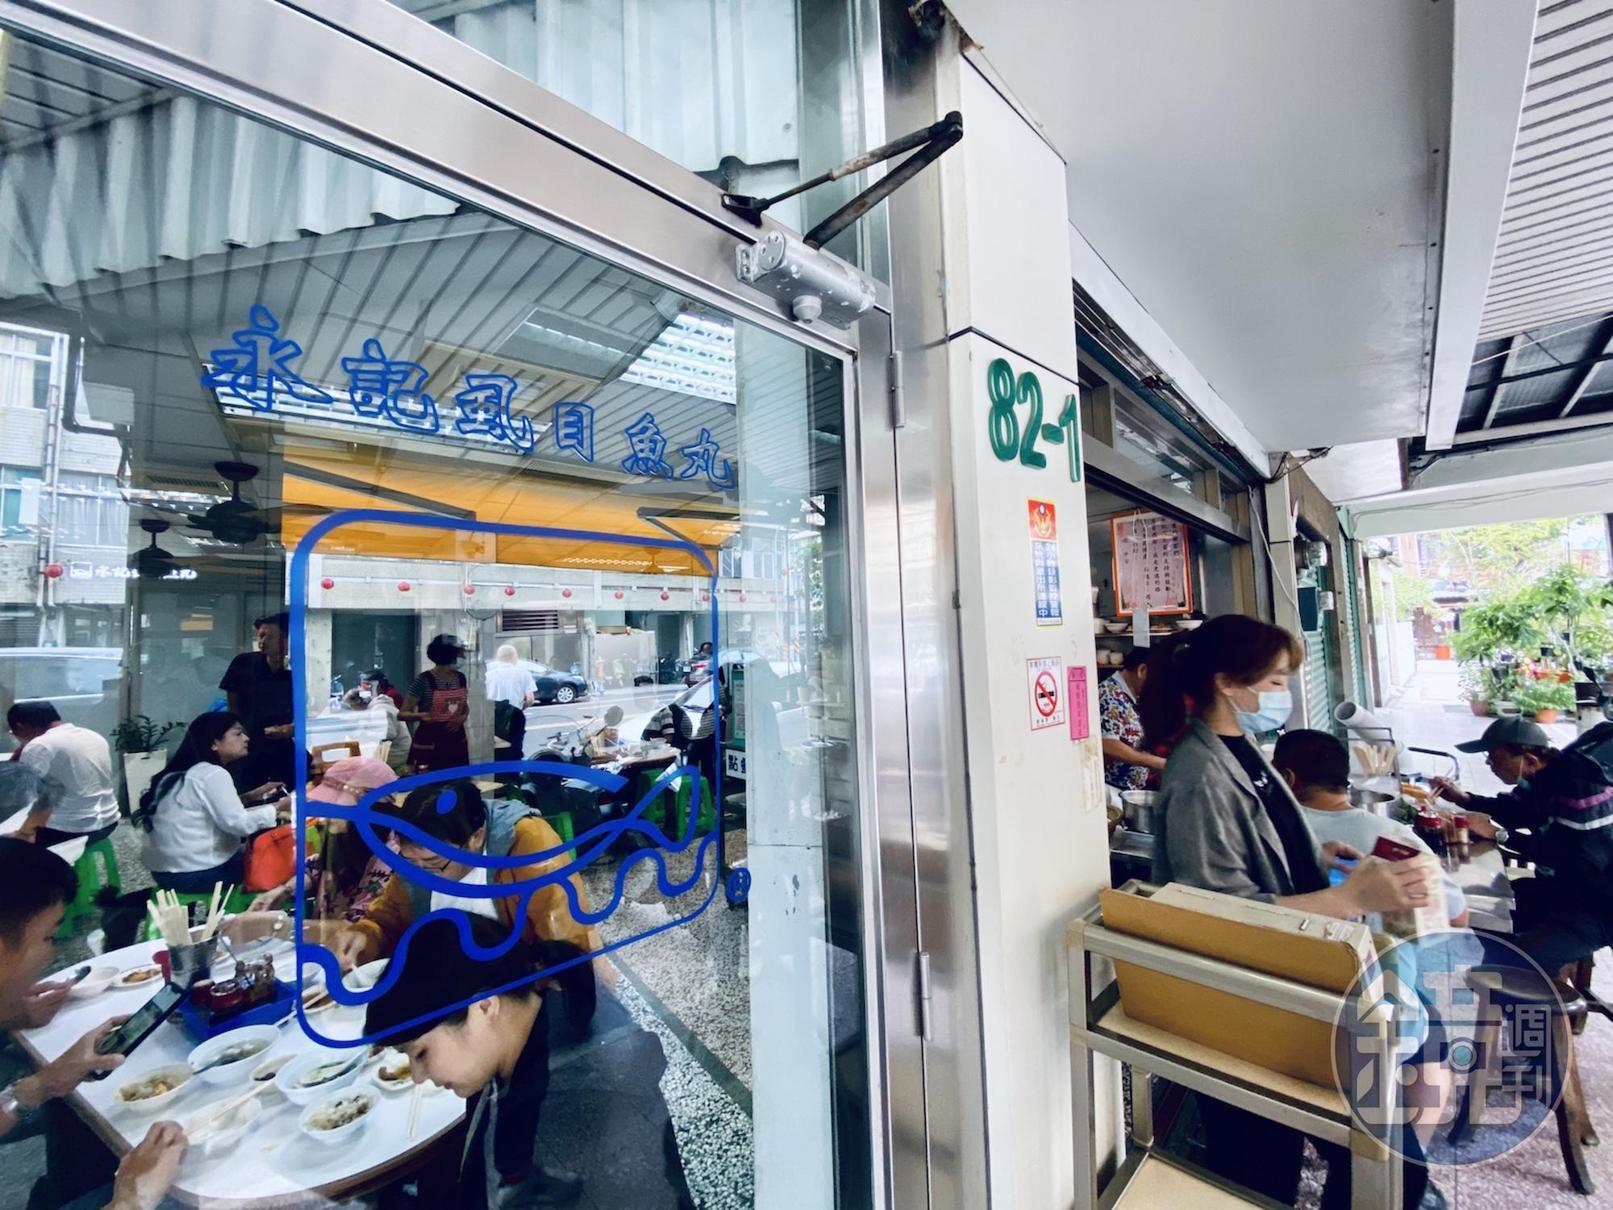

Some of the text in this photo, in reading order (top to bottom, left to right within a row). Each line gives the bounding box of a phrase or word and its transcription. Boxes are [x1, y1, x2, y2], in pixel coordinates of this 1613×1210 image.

[201, 304, 736, 490] 永記虱目魚丸
[988, 358, 1080, 481] 82-1
